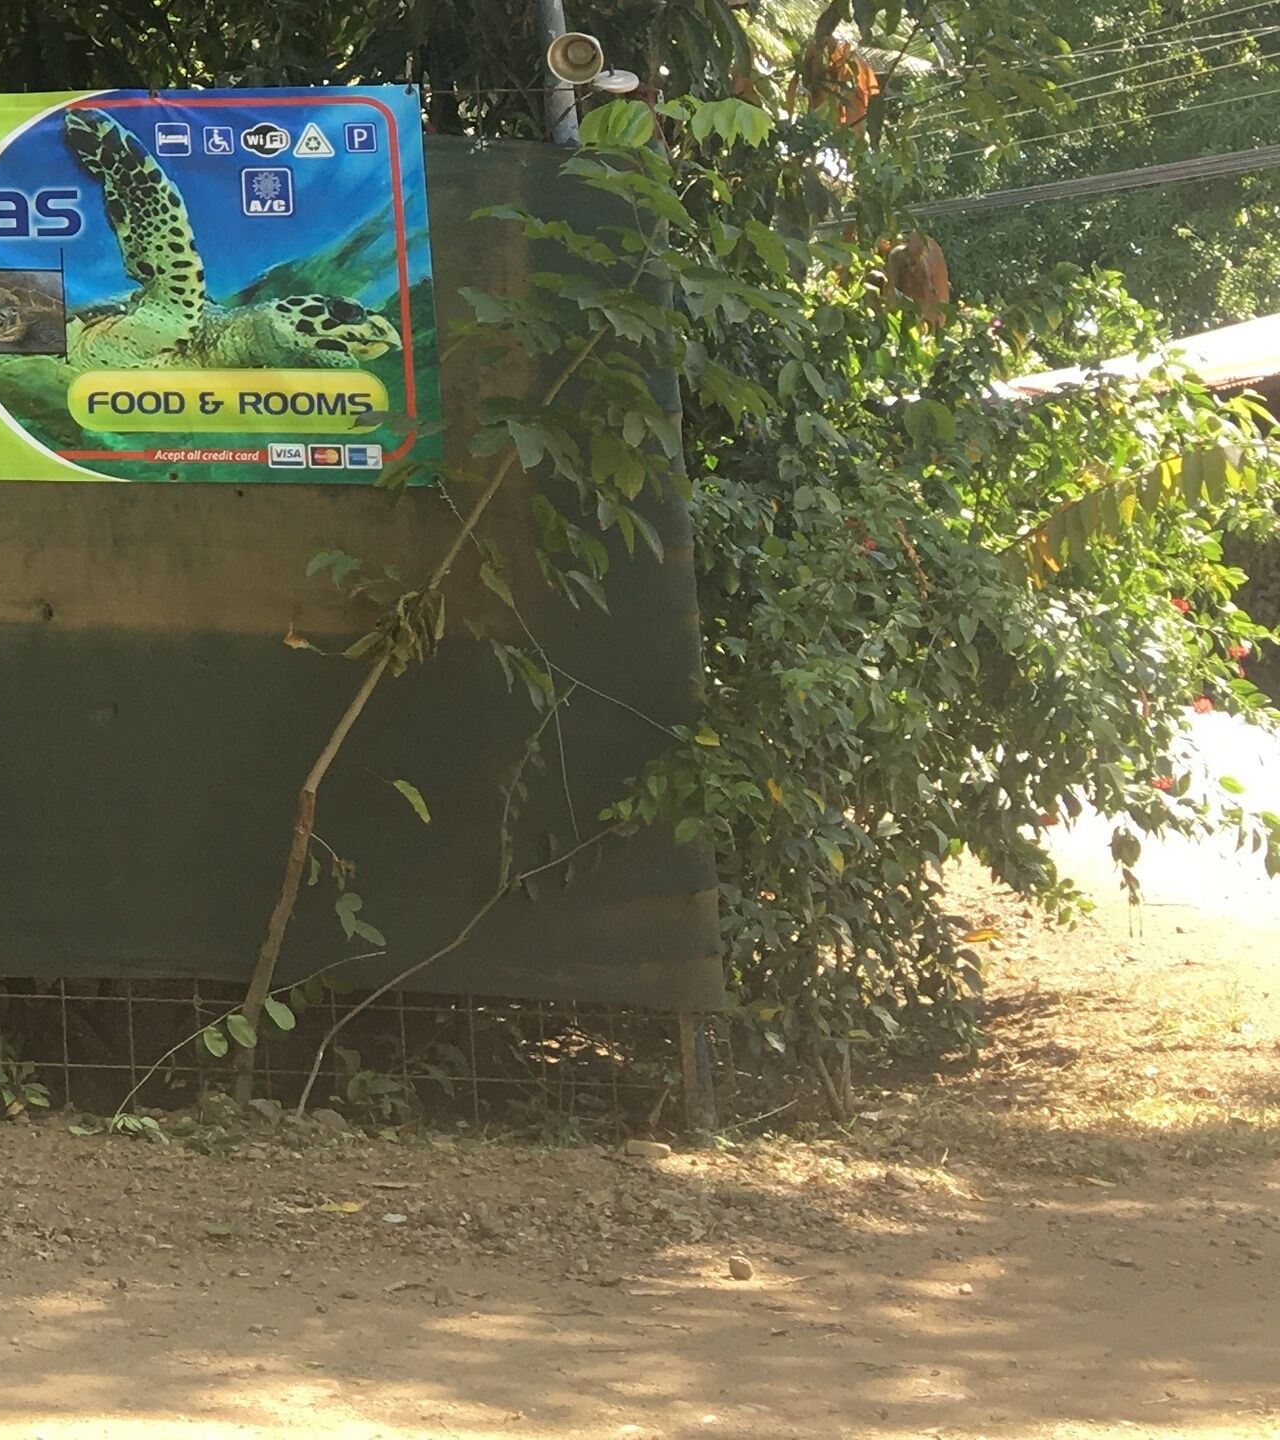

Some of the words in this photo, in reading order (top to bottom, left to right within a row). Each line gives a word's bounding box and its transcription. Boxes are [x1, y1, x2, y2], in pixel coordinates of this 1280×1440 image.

[249, 199, 286, 212] A/C
[88, 391, 185, 415] FOOD
[199, 392, 224, 415] &
[239, 392, 374, 416] ROOMS
[154, 449, 185, 463] Acept
[187, 449, 201, 461] all
[203, 449, 234, 461] credit
[235, 449, 259, 461] card
[275, 448, 302, 459] VISA
